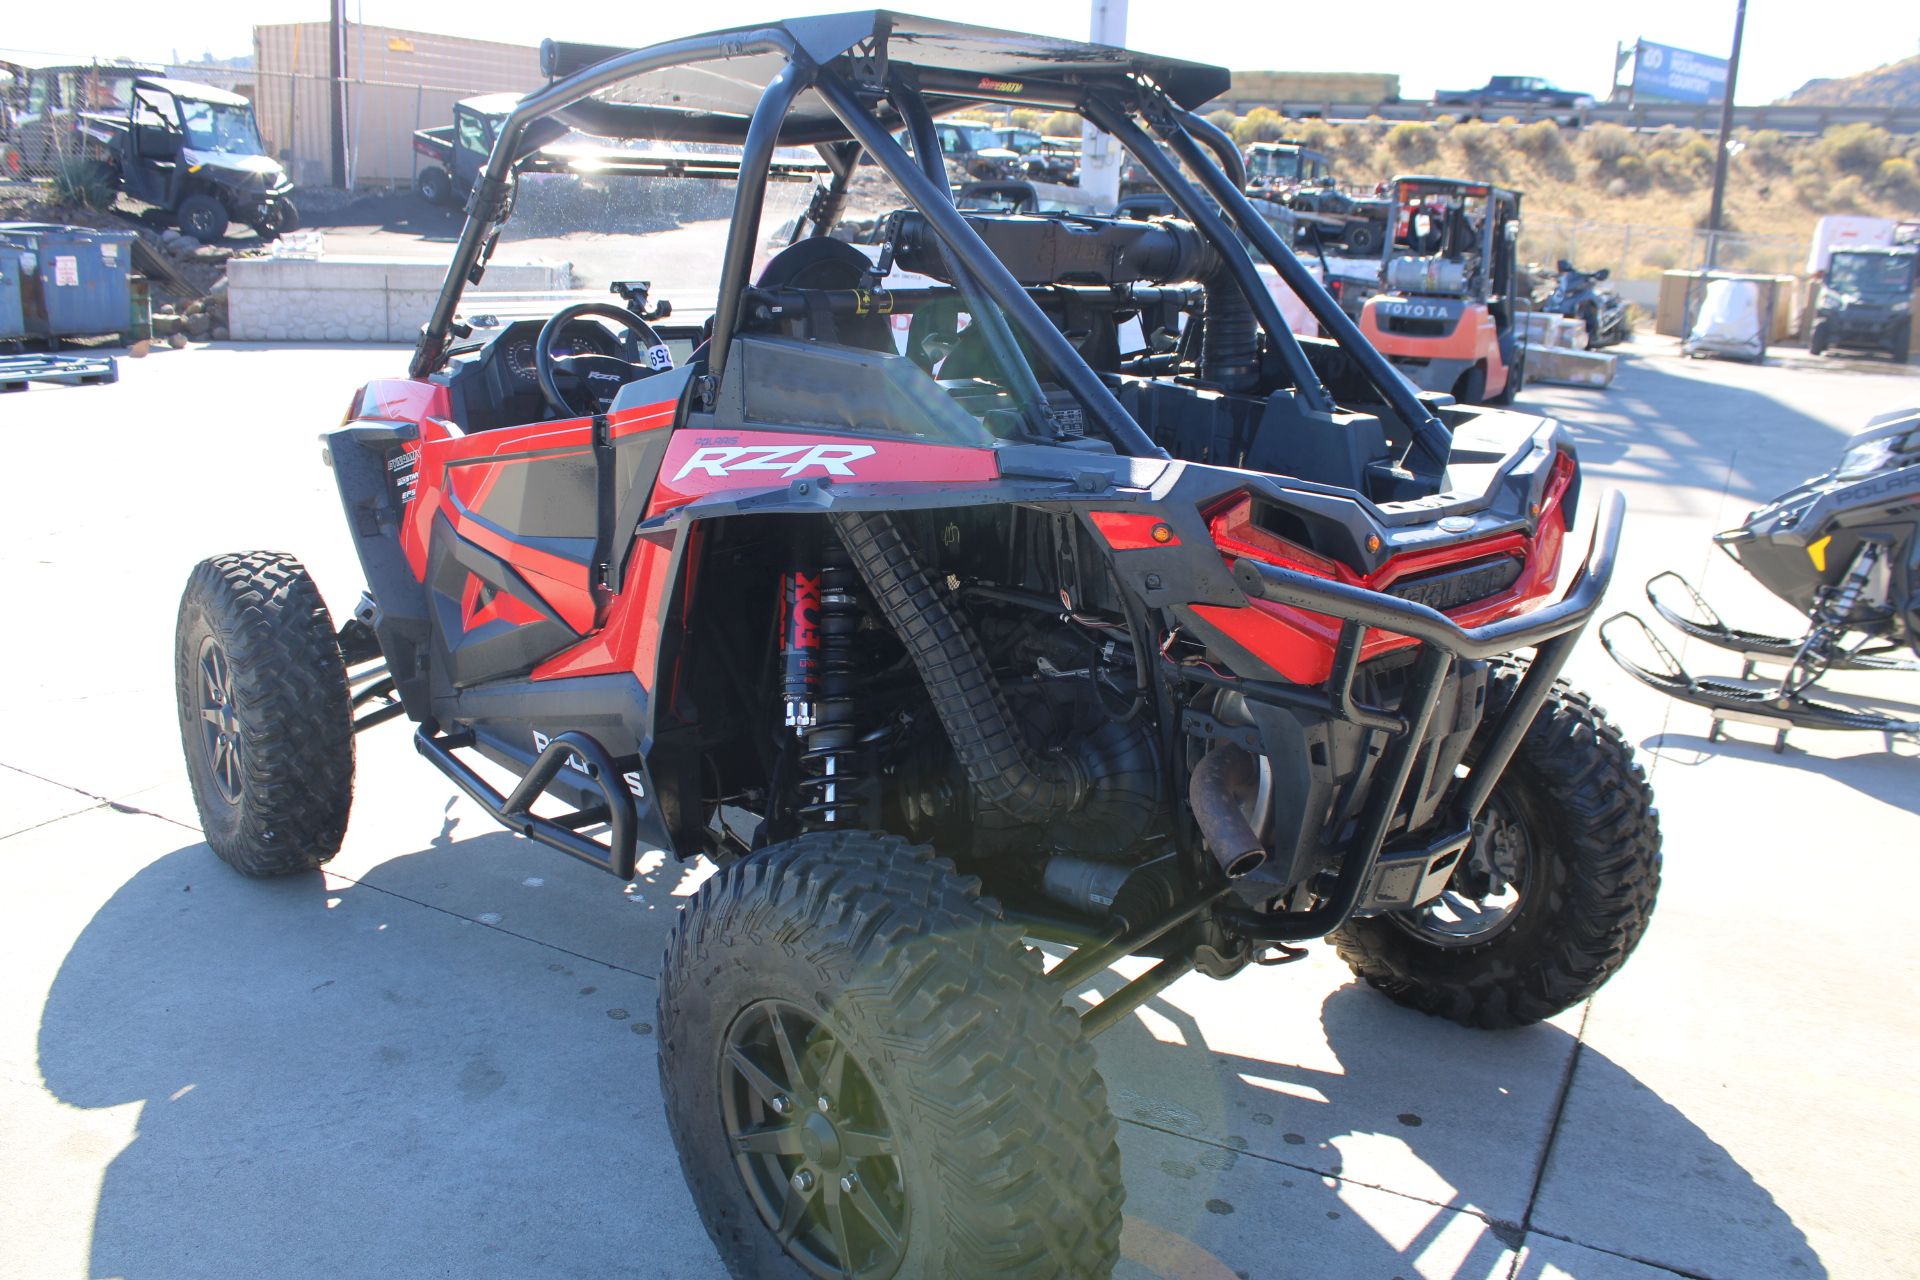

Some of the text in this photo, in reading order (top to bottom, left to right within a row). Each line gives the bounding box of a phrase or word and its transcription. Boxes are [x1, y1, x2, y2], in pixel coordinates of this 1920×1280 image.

[1384, 303, 1449, 318] TOYOTA
[588, 371, 621, 381] RZR
[694, 436, 739, 446] POLARIS
[672, 444, 877, 482] RZR
[793, 571, 820, 650] FOX
